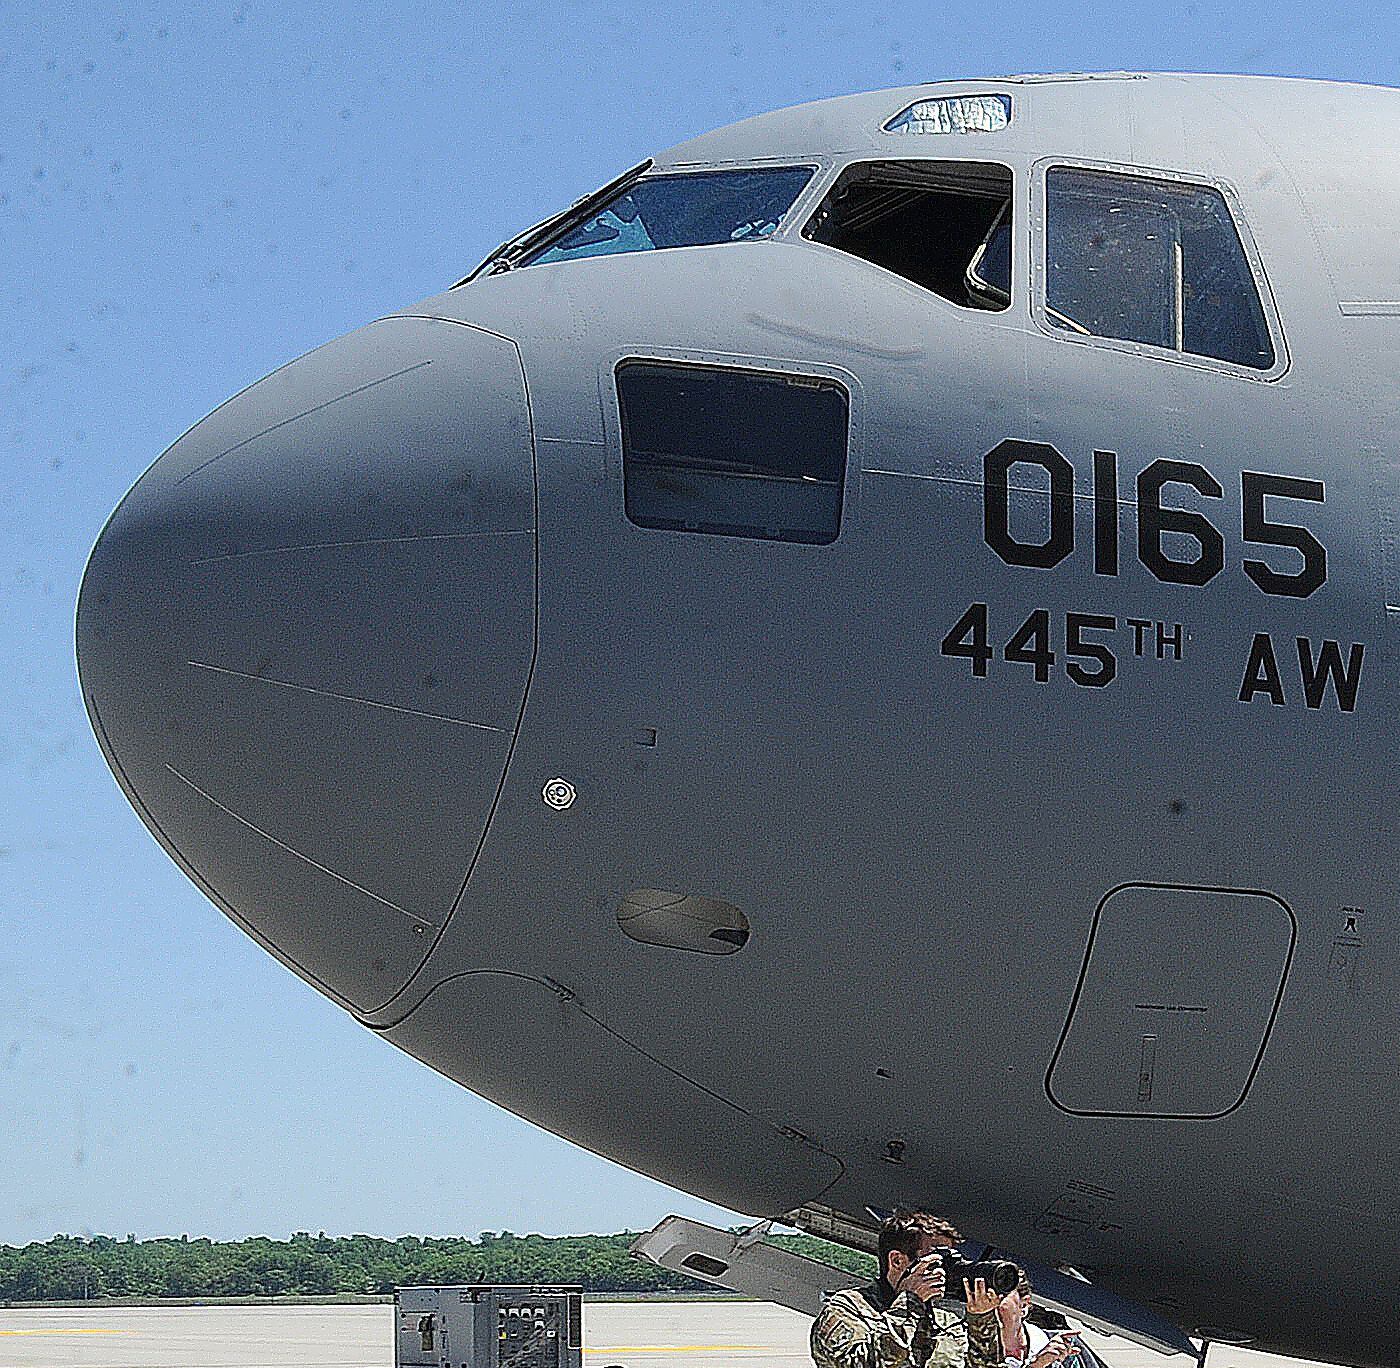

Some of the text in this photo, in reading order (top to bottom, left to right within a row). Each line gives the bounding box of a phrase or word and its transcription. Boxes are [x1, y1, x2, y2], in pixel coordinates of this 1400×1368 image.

[983, 438, 1328, 599] 0165
[940, 602, 1365, 713] 445TH AW
